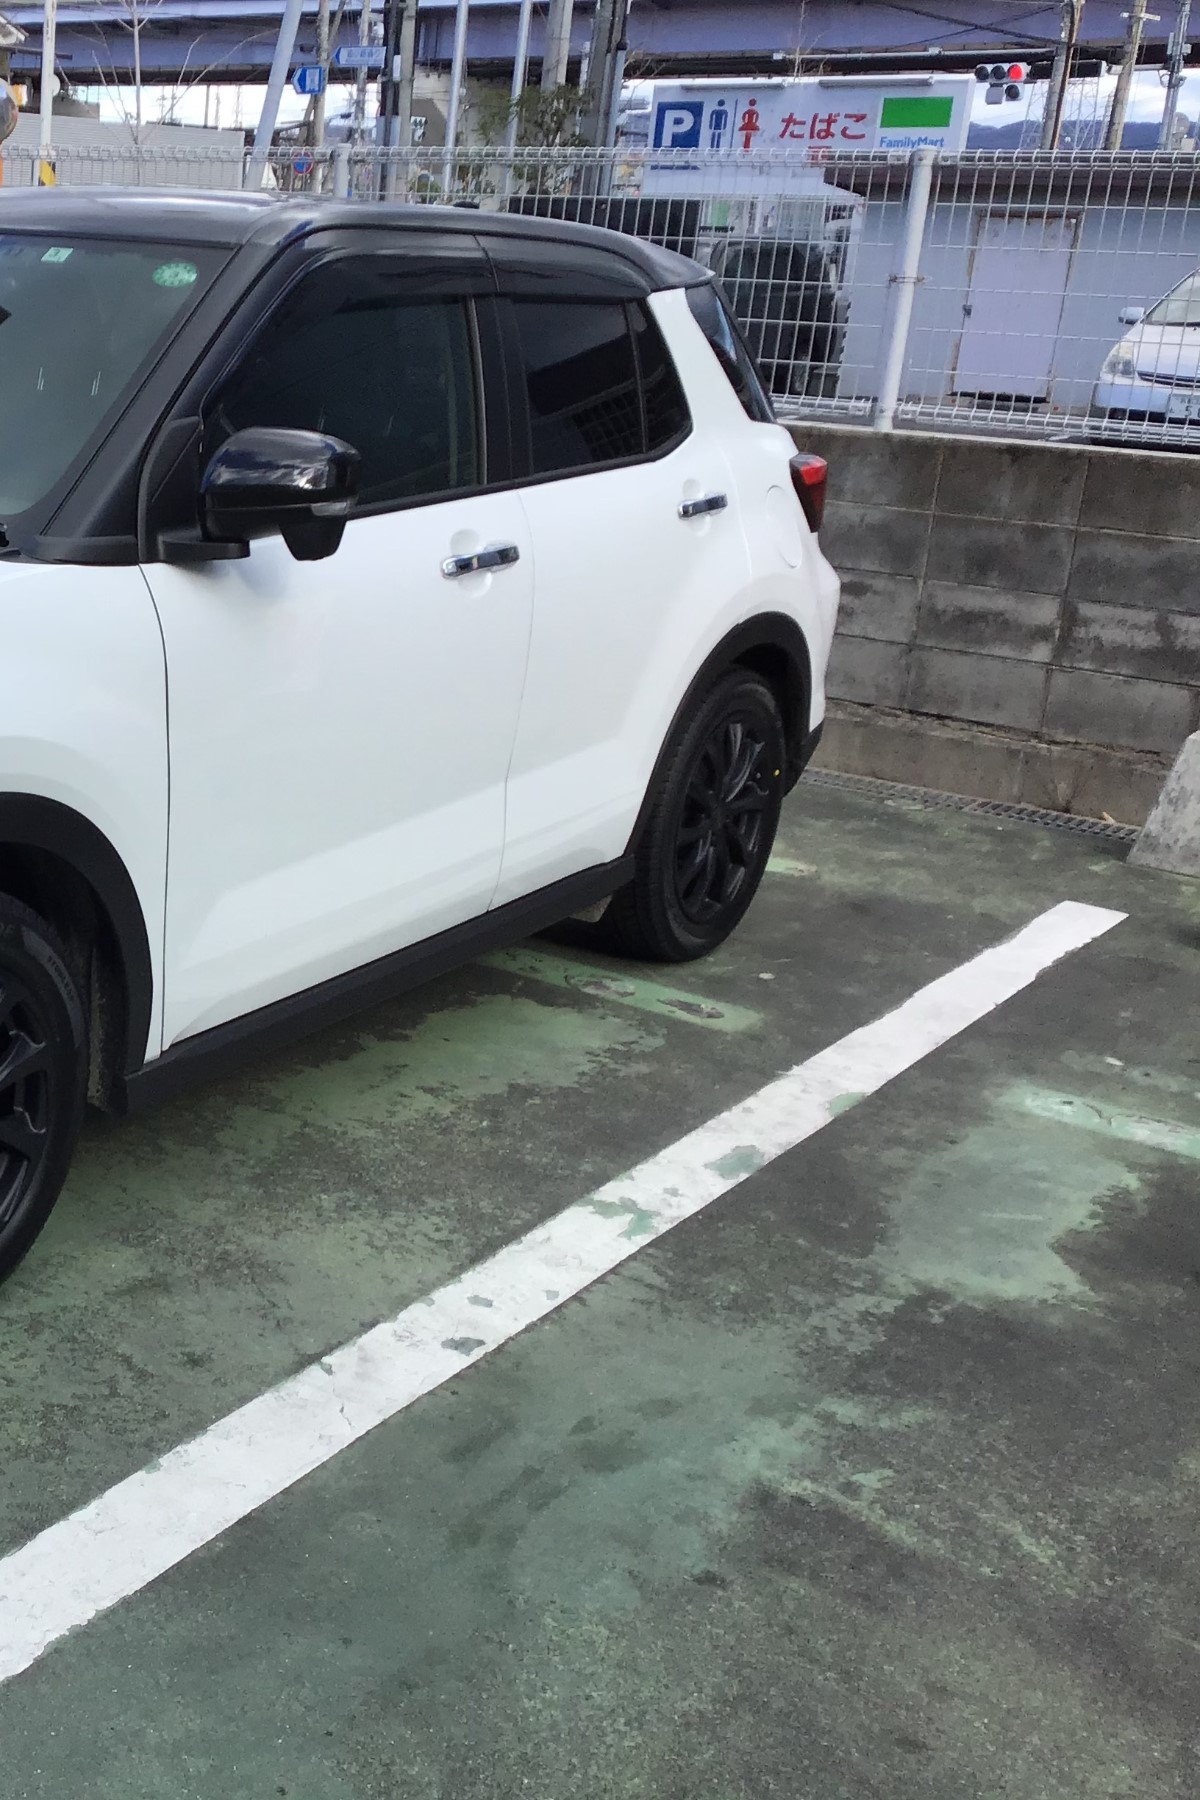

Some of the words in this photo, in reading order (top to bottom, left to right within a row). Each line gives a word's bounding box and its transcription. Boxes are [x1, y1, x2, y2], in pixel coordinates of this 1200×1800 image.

[661, 109, 695, 147] P
[779, 112, 868, 140] たばこ
[880, 136, 945, 149] FamilyMart
